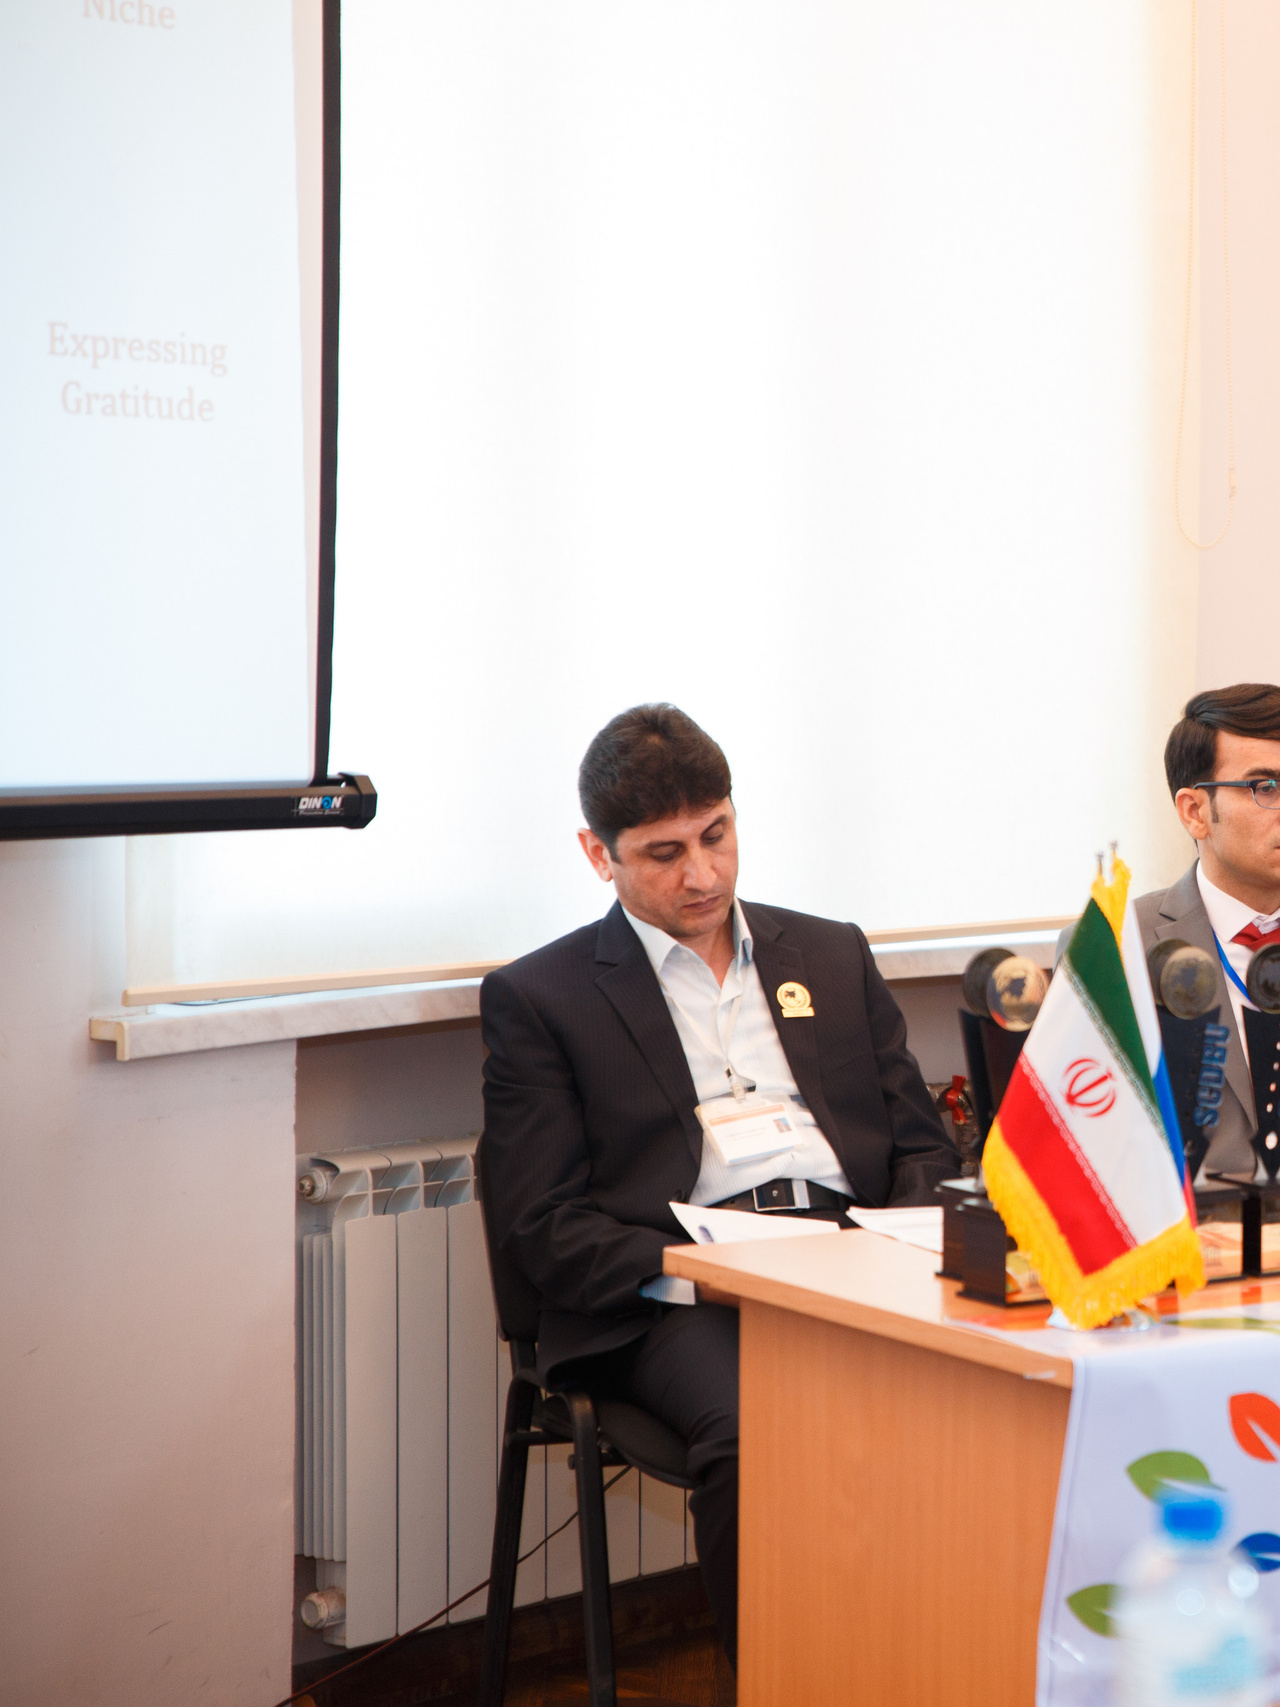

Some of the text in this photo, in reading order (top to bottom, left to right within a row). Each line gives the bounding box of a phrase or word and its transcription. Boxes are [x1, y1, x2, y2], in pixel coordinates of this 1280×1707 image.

[83, 0, 177, 30] Niche
[48, 321, 228, 377] Expressing
[62, 380, 215, 422] Gratitude
[1193, 1023, 1231, 1128] SCDBU
